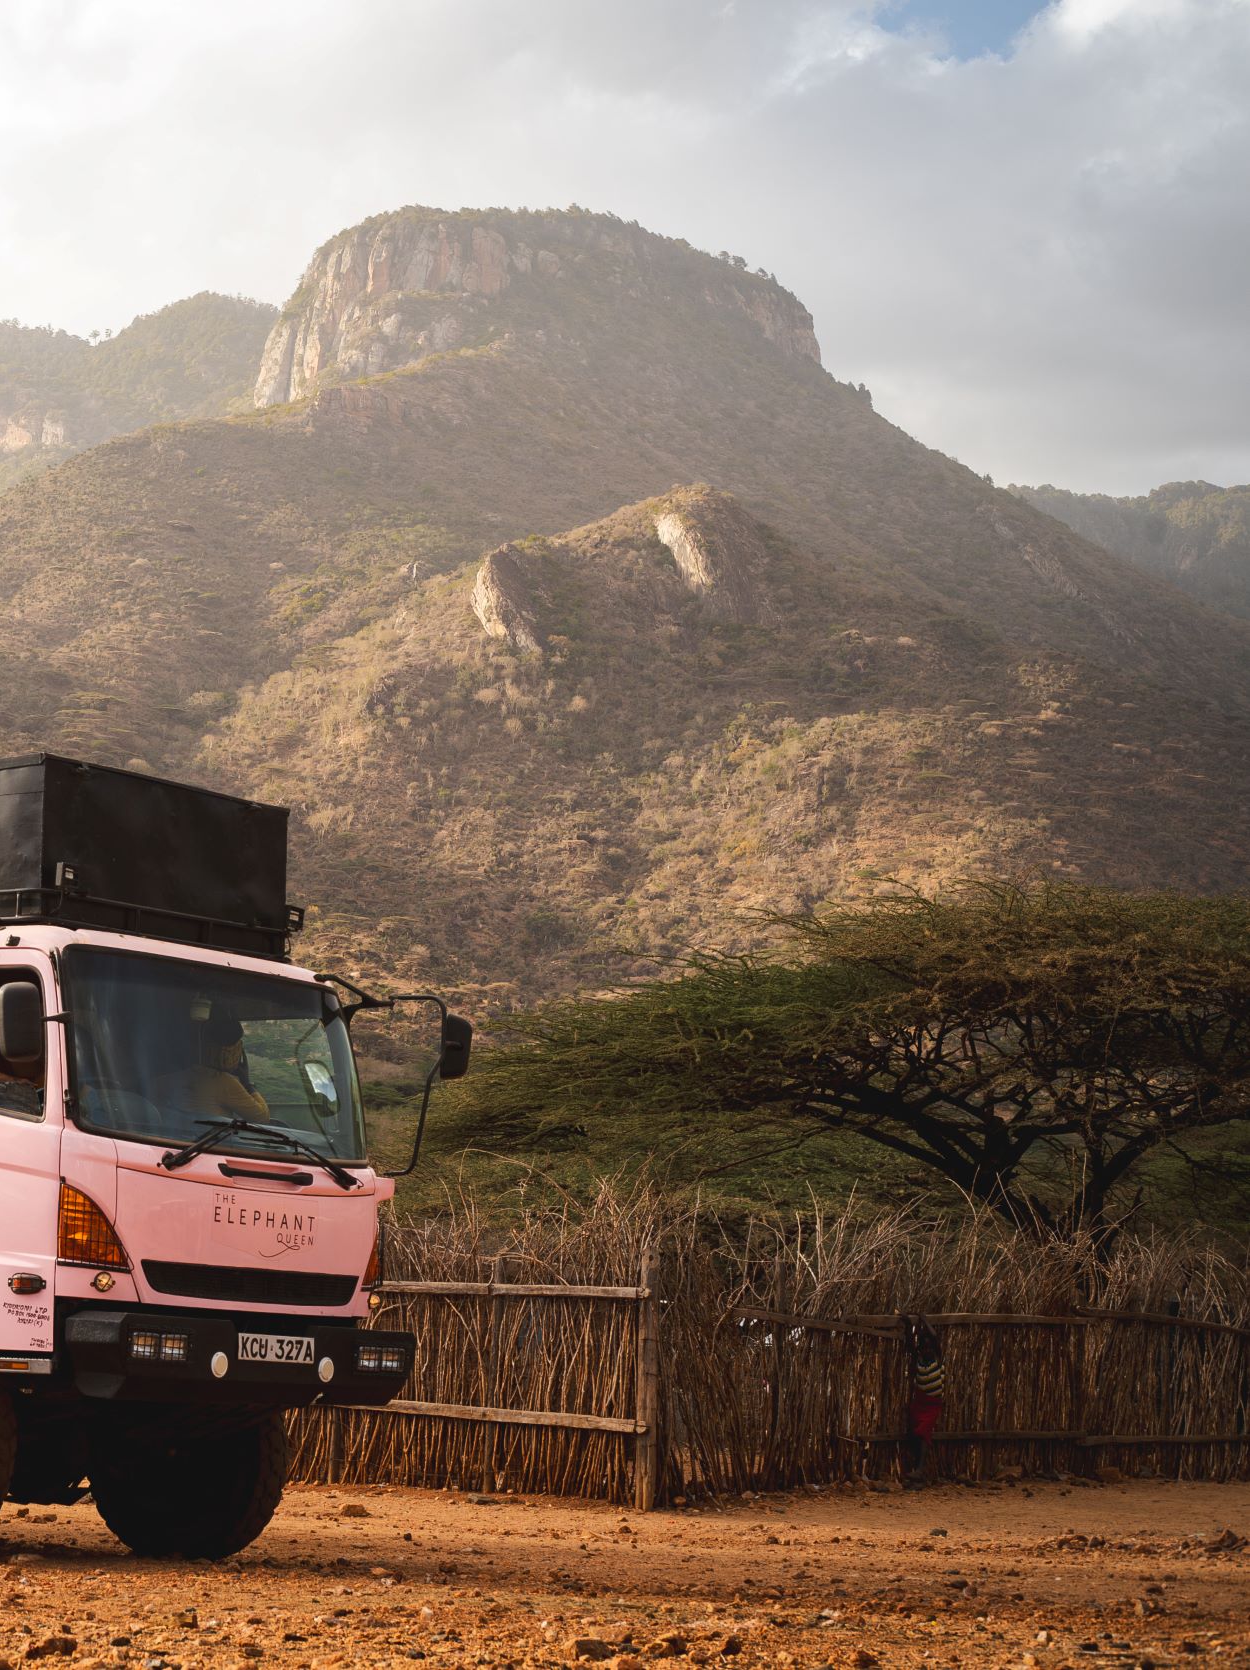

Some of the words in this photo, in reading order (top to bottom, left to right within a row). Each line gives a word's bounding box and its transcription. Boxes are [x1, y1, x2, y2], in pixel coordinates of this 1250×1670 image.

[216, 1193, 236, 1204] THE
[214, 1206, 315, 1232] ELEPHANT
[240, 1336, 268, 1360] KCU
[275, 1339, 313, 1362] 327A
